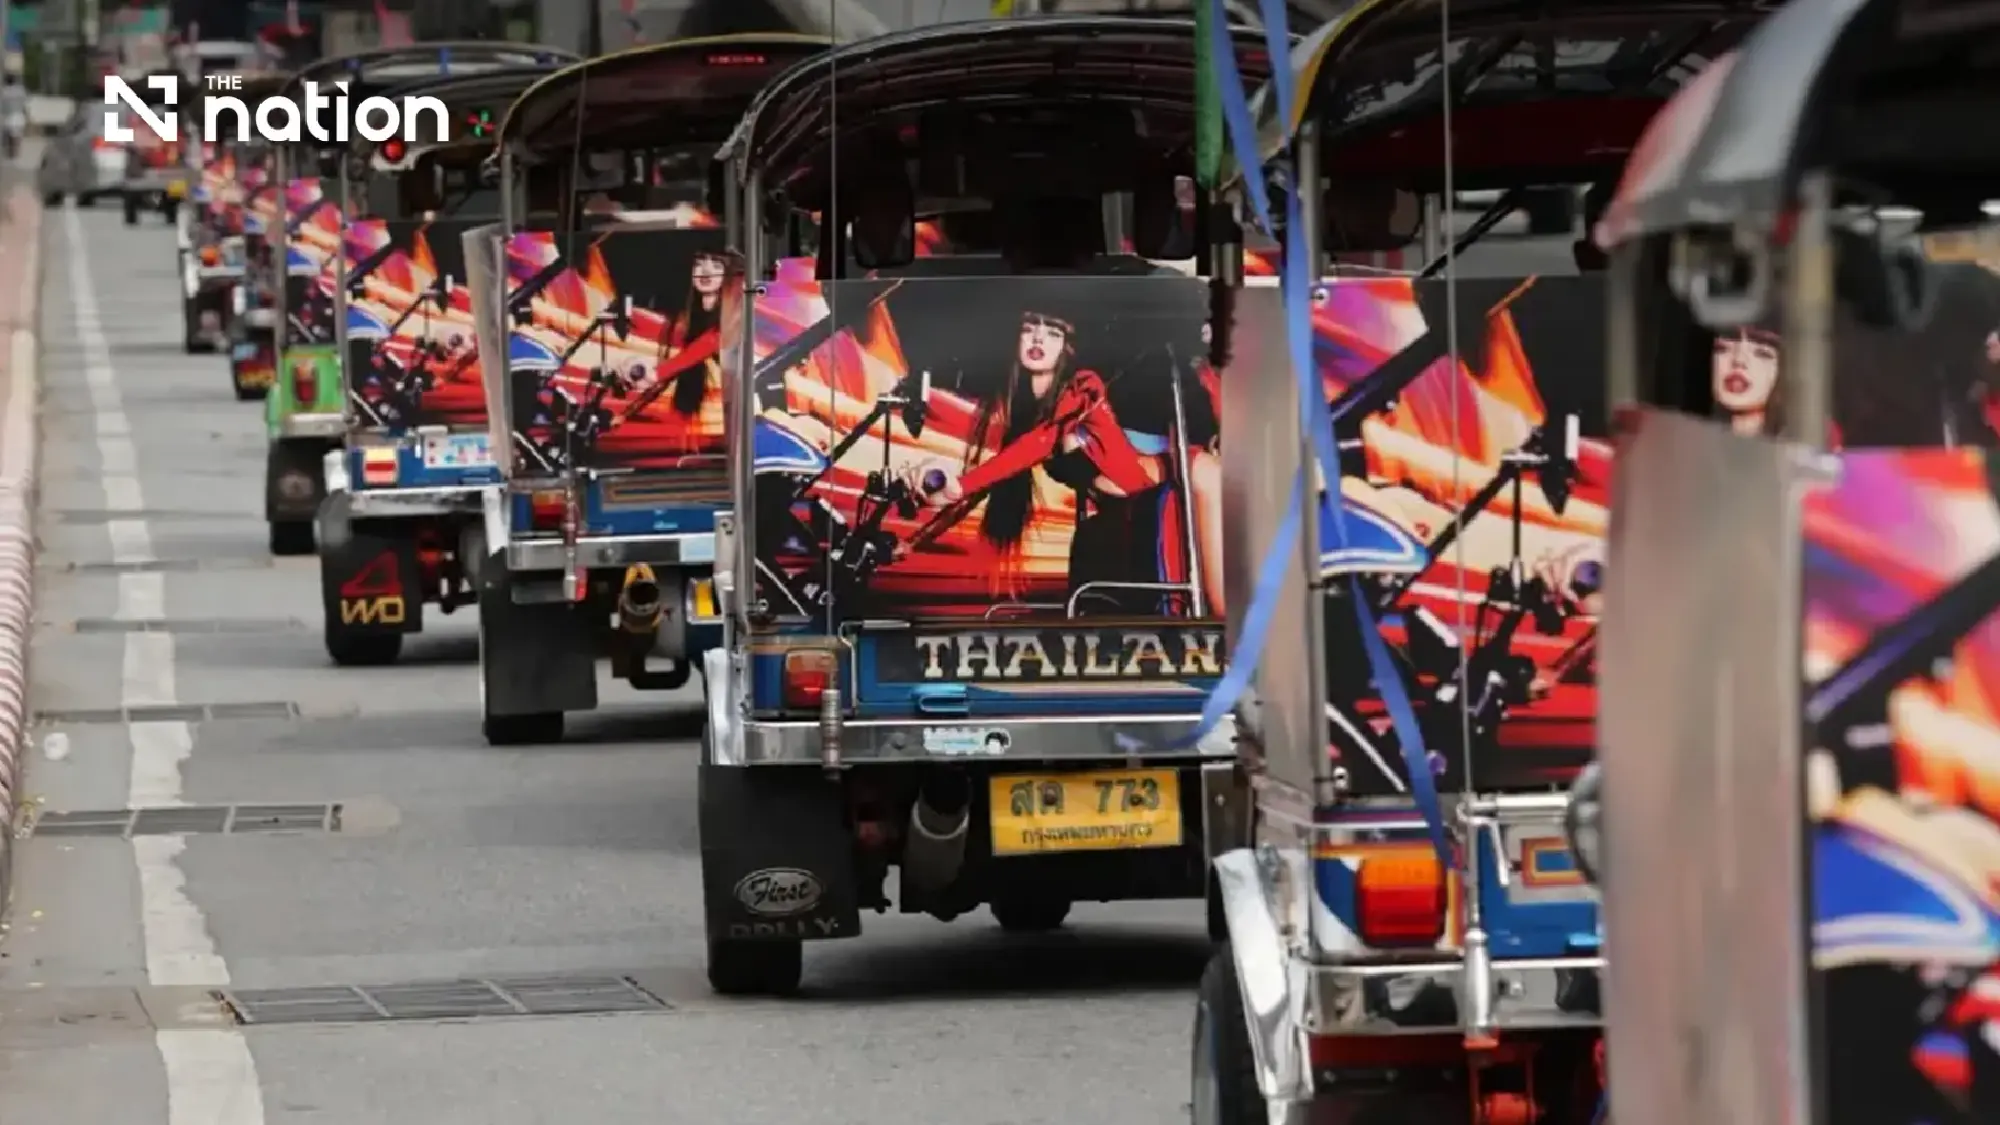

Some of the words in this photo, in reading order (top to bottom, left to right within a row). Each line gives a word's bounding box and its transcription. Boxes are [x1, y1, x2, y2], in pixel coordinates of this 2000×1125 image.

[916, 633, 1229, 678] THAILAN
[1094, 777, 1160, 813] 773
[750, 876, 811, 906] First
